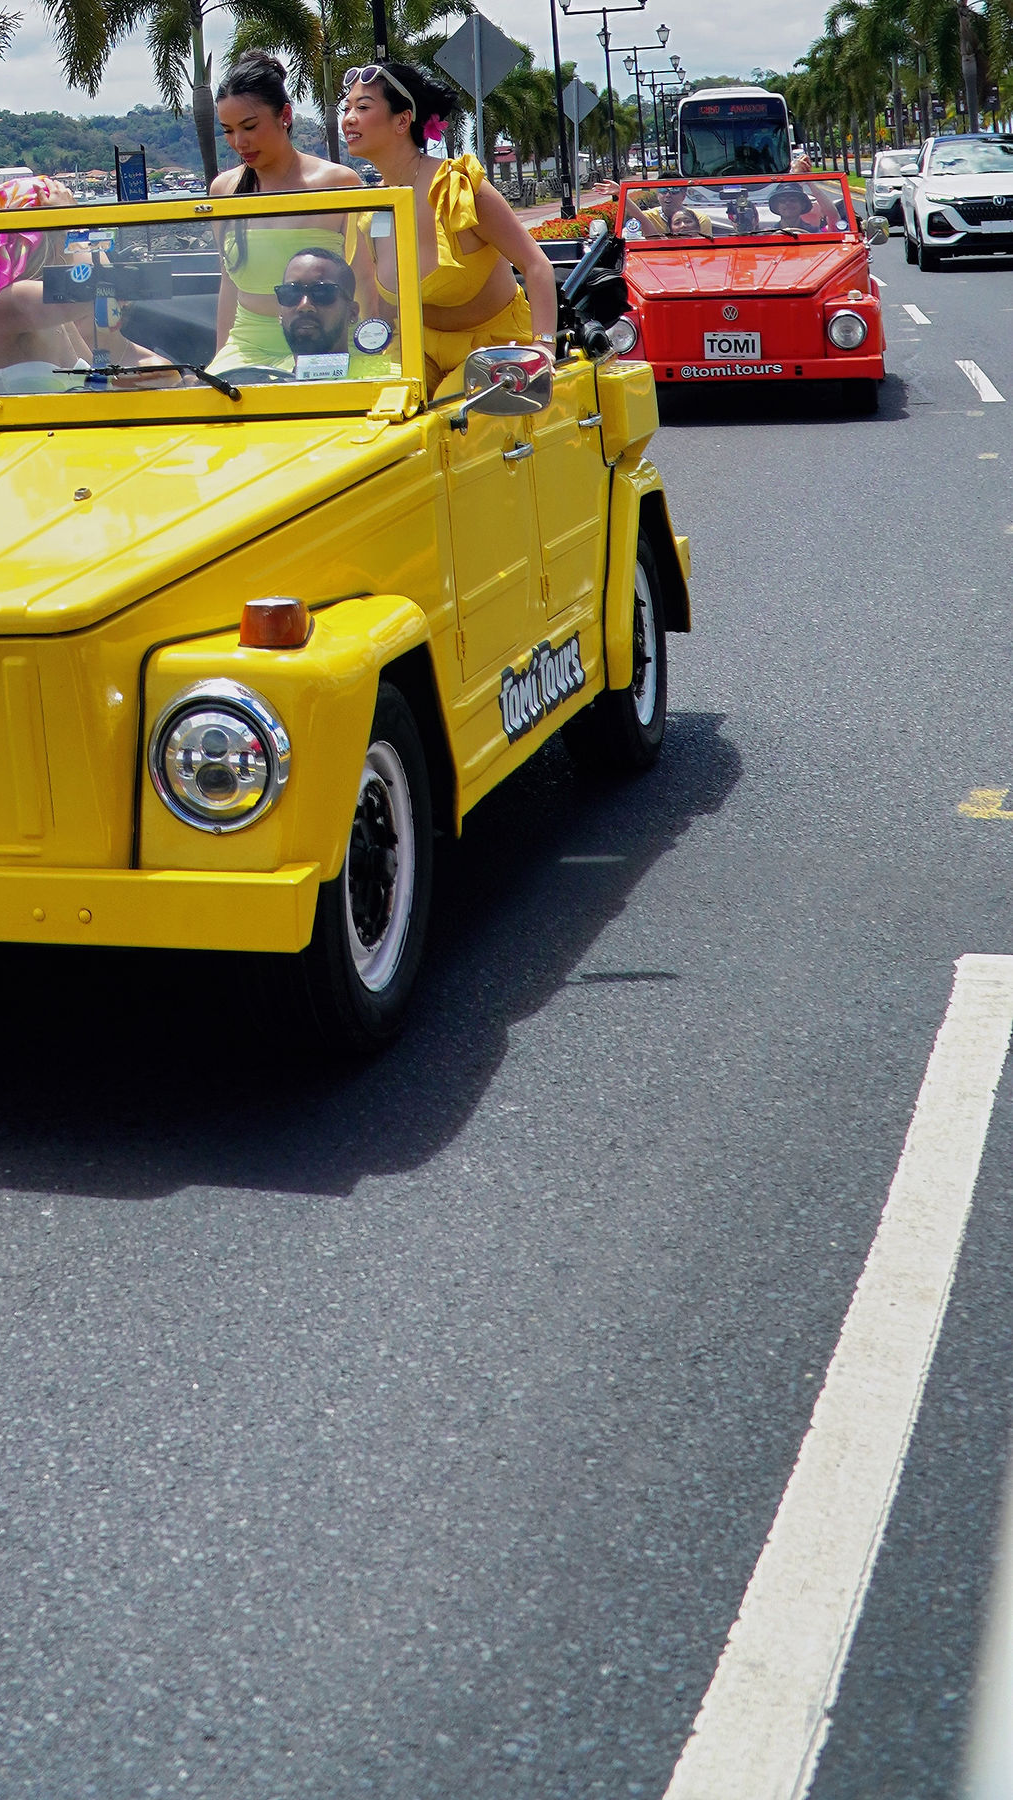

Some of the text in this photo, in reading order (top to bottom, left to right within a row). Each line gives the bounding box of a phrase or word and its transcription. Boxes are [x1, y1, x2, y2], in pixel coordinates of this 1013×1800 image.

[730, 104, 768, 113] AMADOR
[70, 264, 92, 283] VW
[722, 305, 738, 321] VW
[706, 338, 756, 354] TOMI
[680, 363, 783, 379] @tomi.tours
